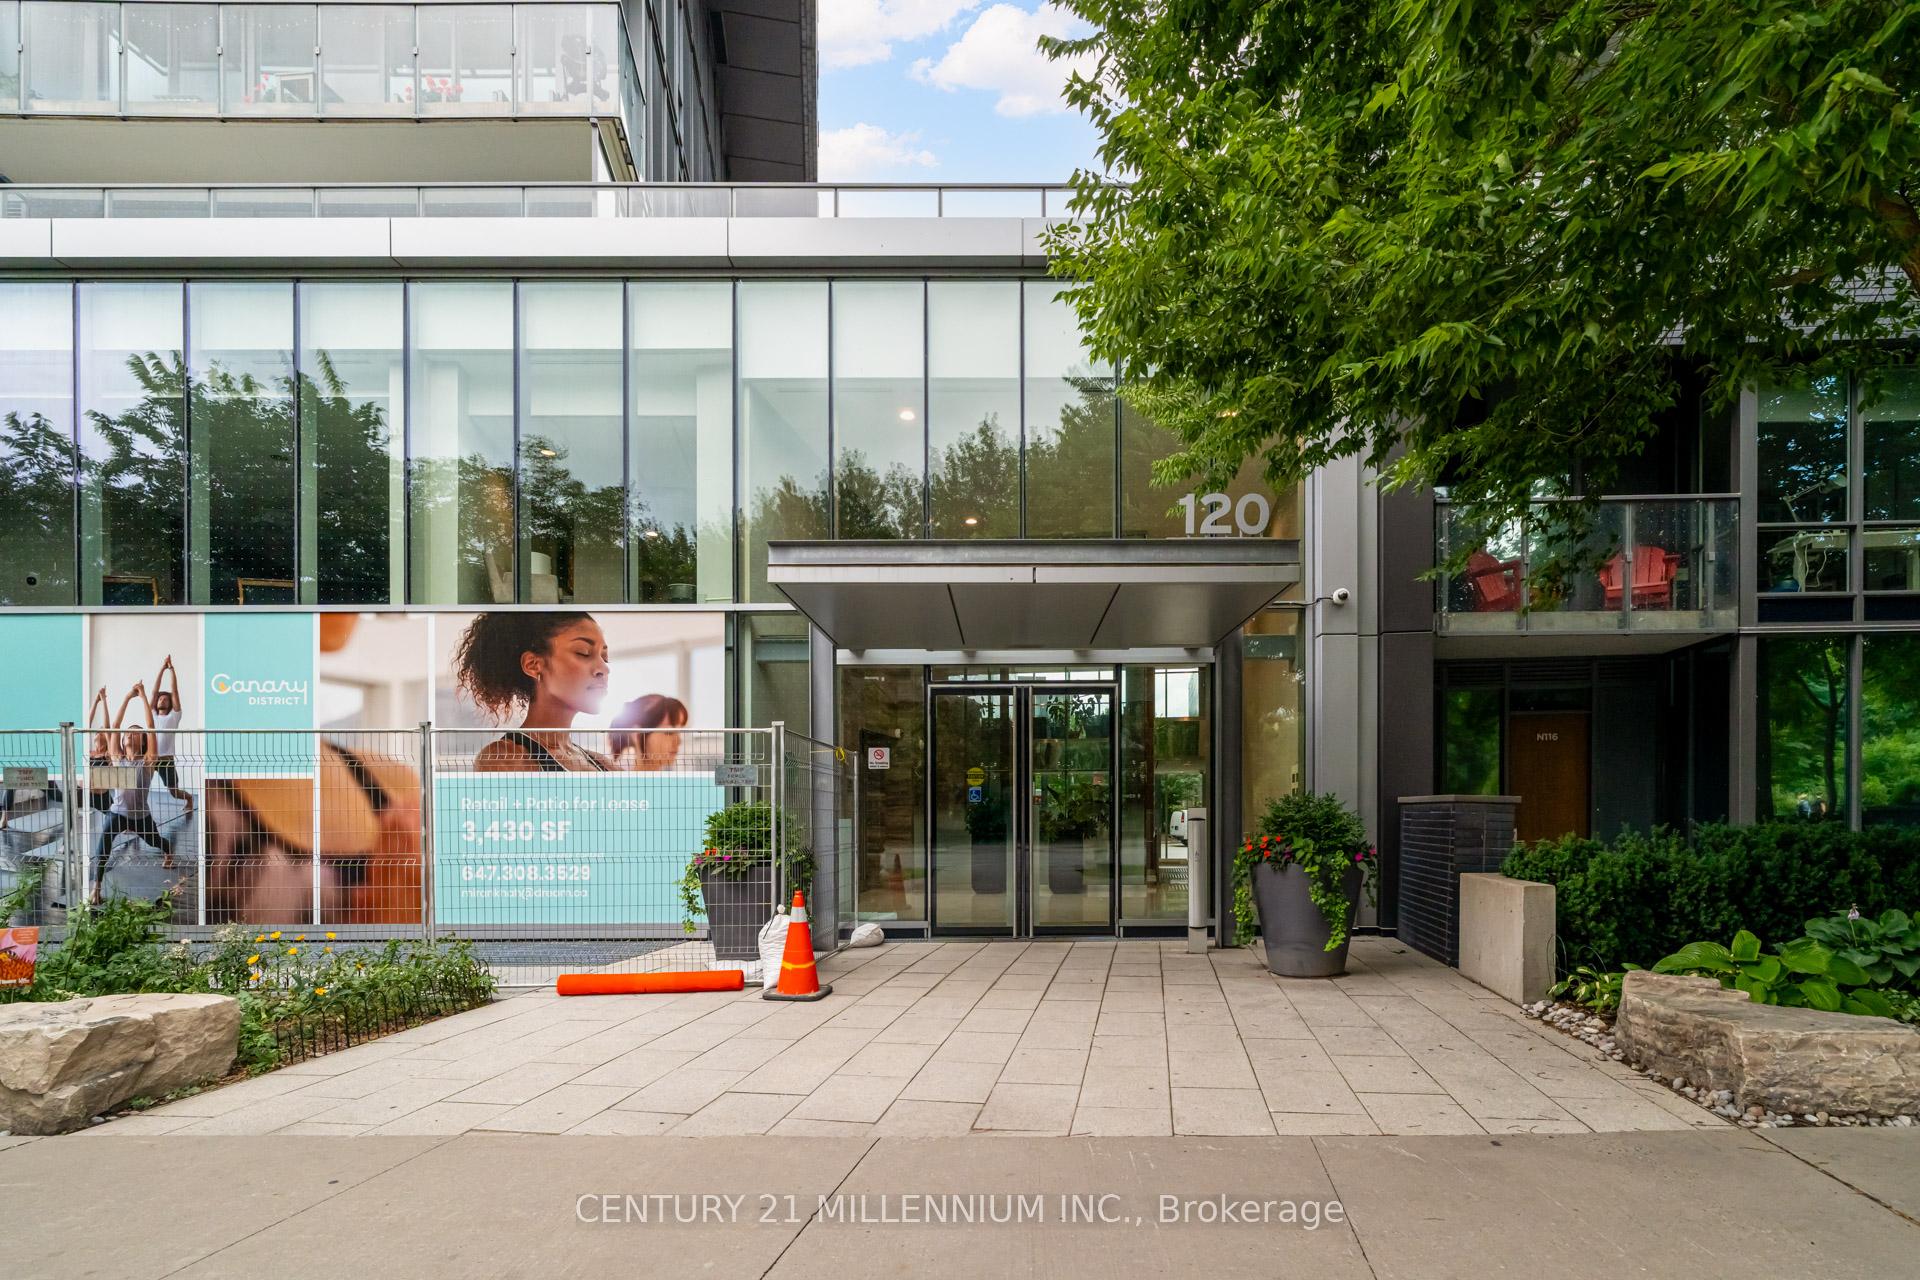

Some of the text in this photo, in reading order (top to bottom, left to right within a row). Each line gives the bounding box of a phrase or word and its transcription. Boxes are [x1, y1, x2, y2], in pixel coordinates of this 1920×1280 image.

[1178, 492, 1270, 534] 120
[211, 673, 307, 705] Canary
[248, 696, 300, 705] DISTRICT
[1536, 732, 1559, 741] N116
[461, 796, 508, 812] Retail
[526, 796, 569, 812] Patio
[573, 796, 597, 812] for
[462, 820, 572, 846] 3,430 SF
